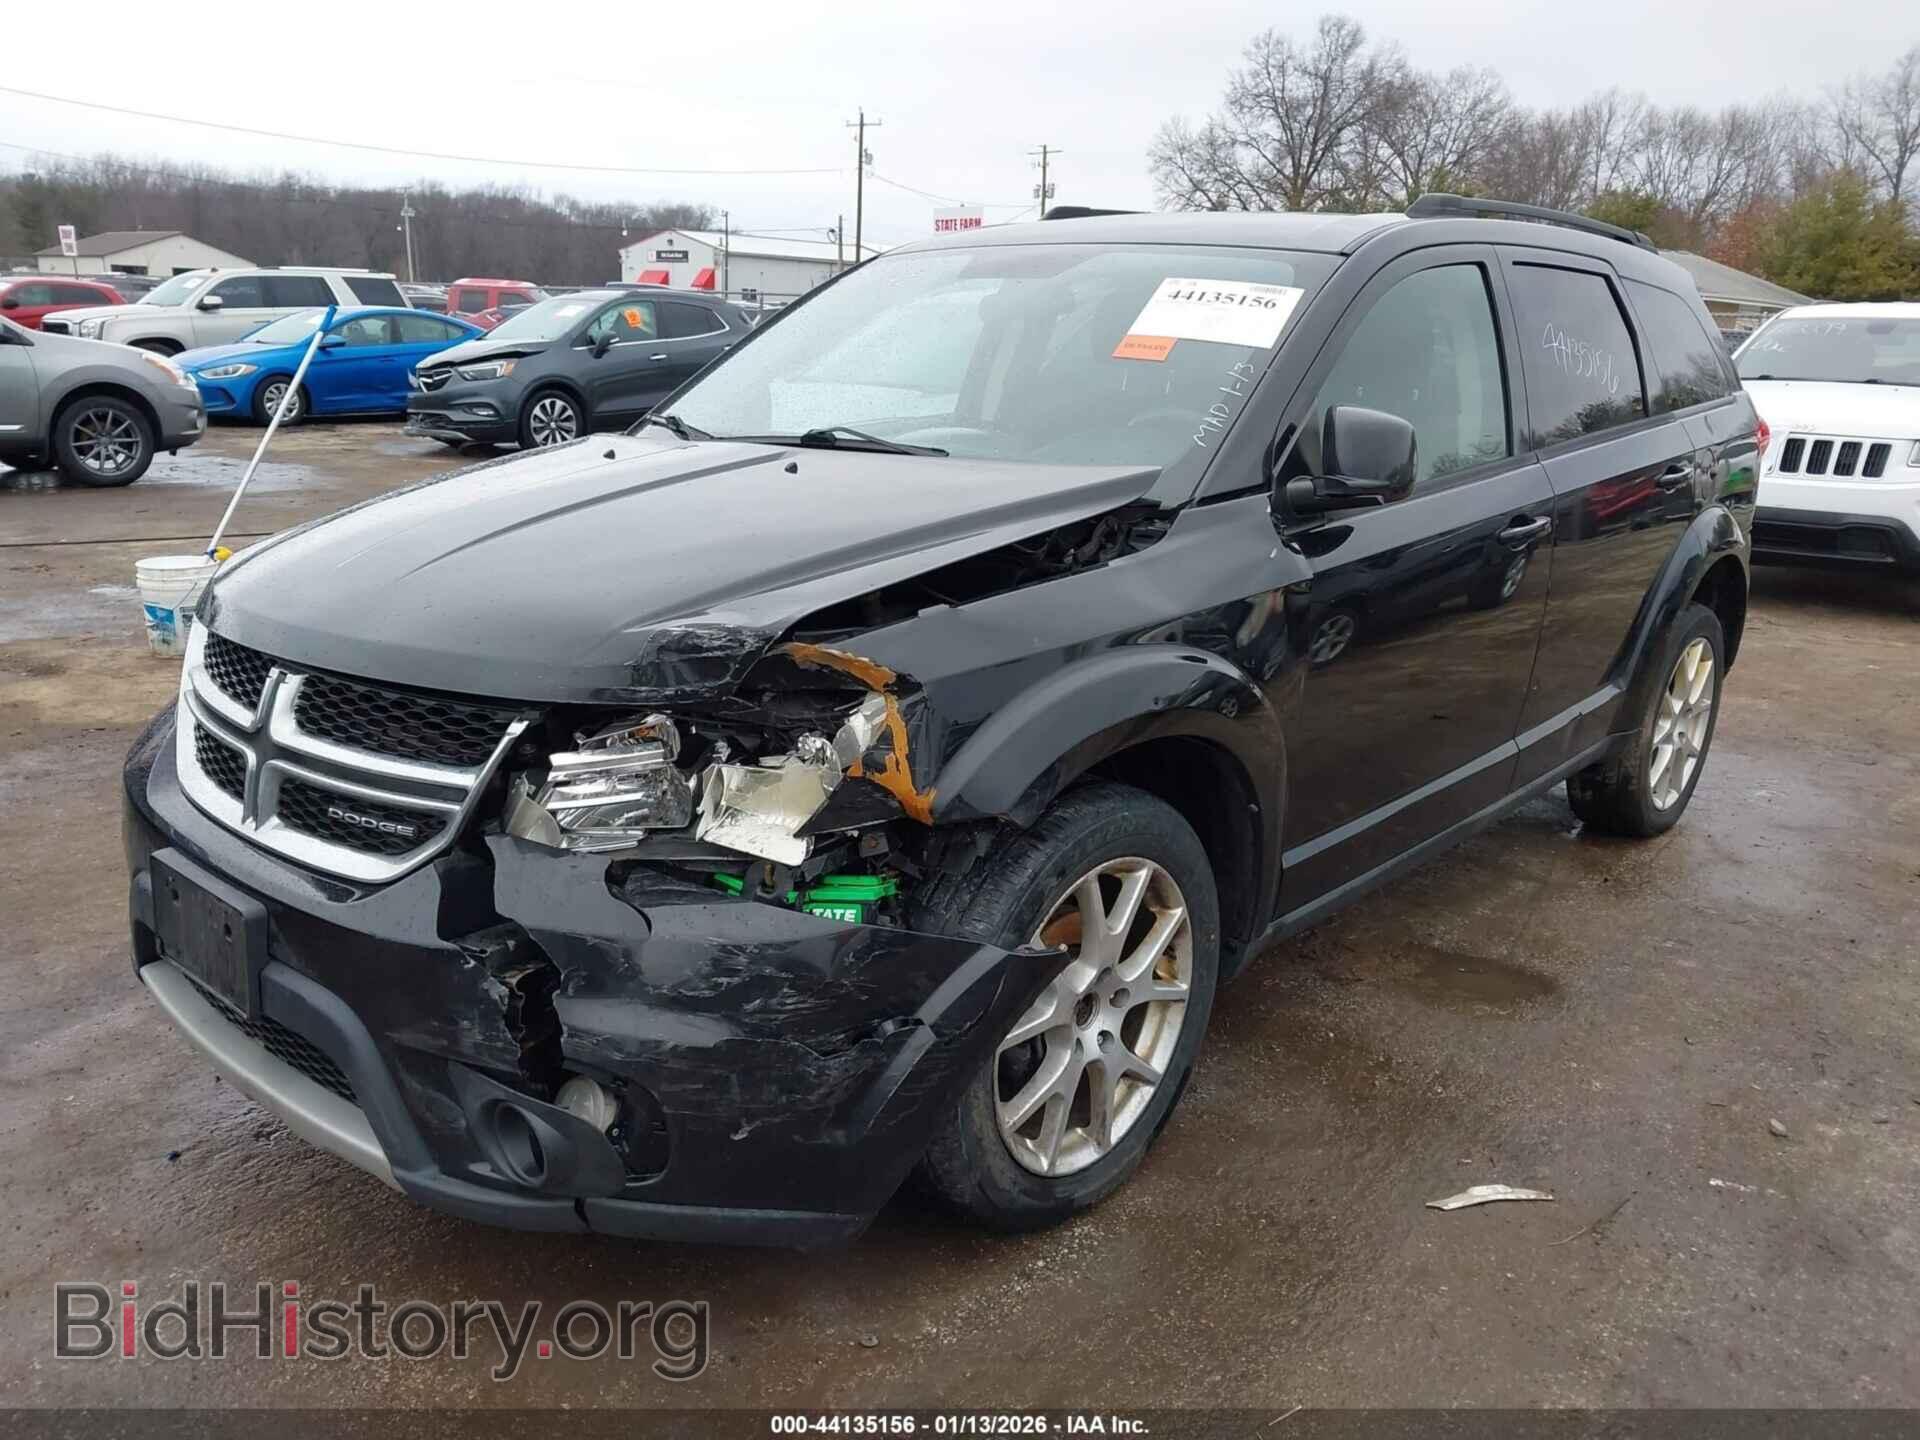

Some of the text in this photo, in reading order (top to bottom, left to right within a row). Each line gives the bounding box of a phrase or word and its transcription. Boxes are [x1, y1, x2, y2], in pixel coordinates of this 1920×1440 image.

[935, 217, 982, 232] STATE FARM
[1167, 289, 1277, 310] 44135156
[328, 807, 416, 837] DODGE
[811, 908, 857, 922] TATE
